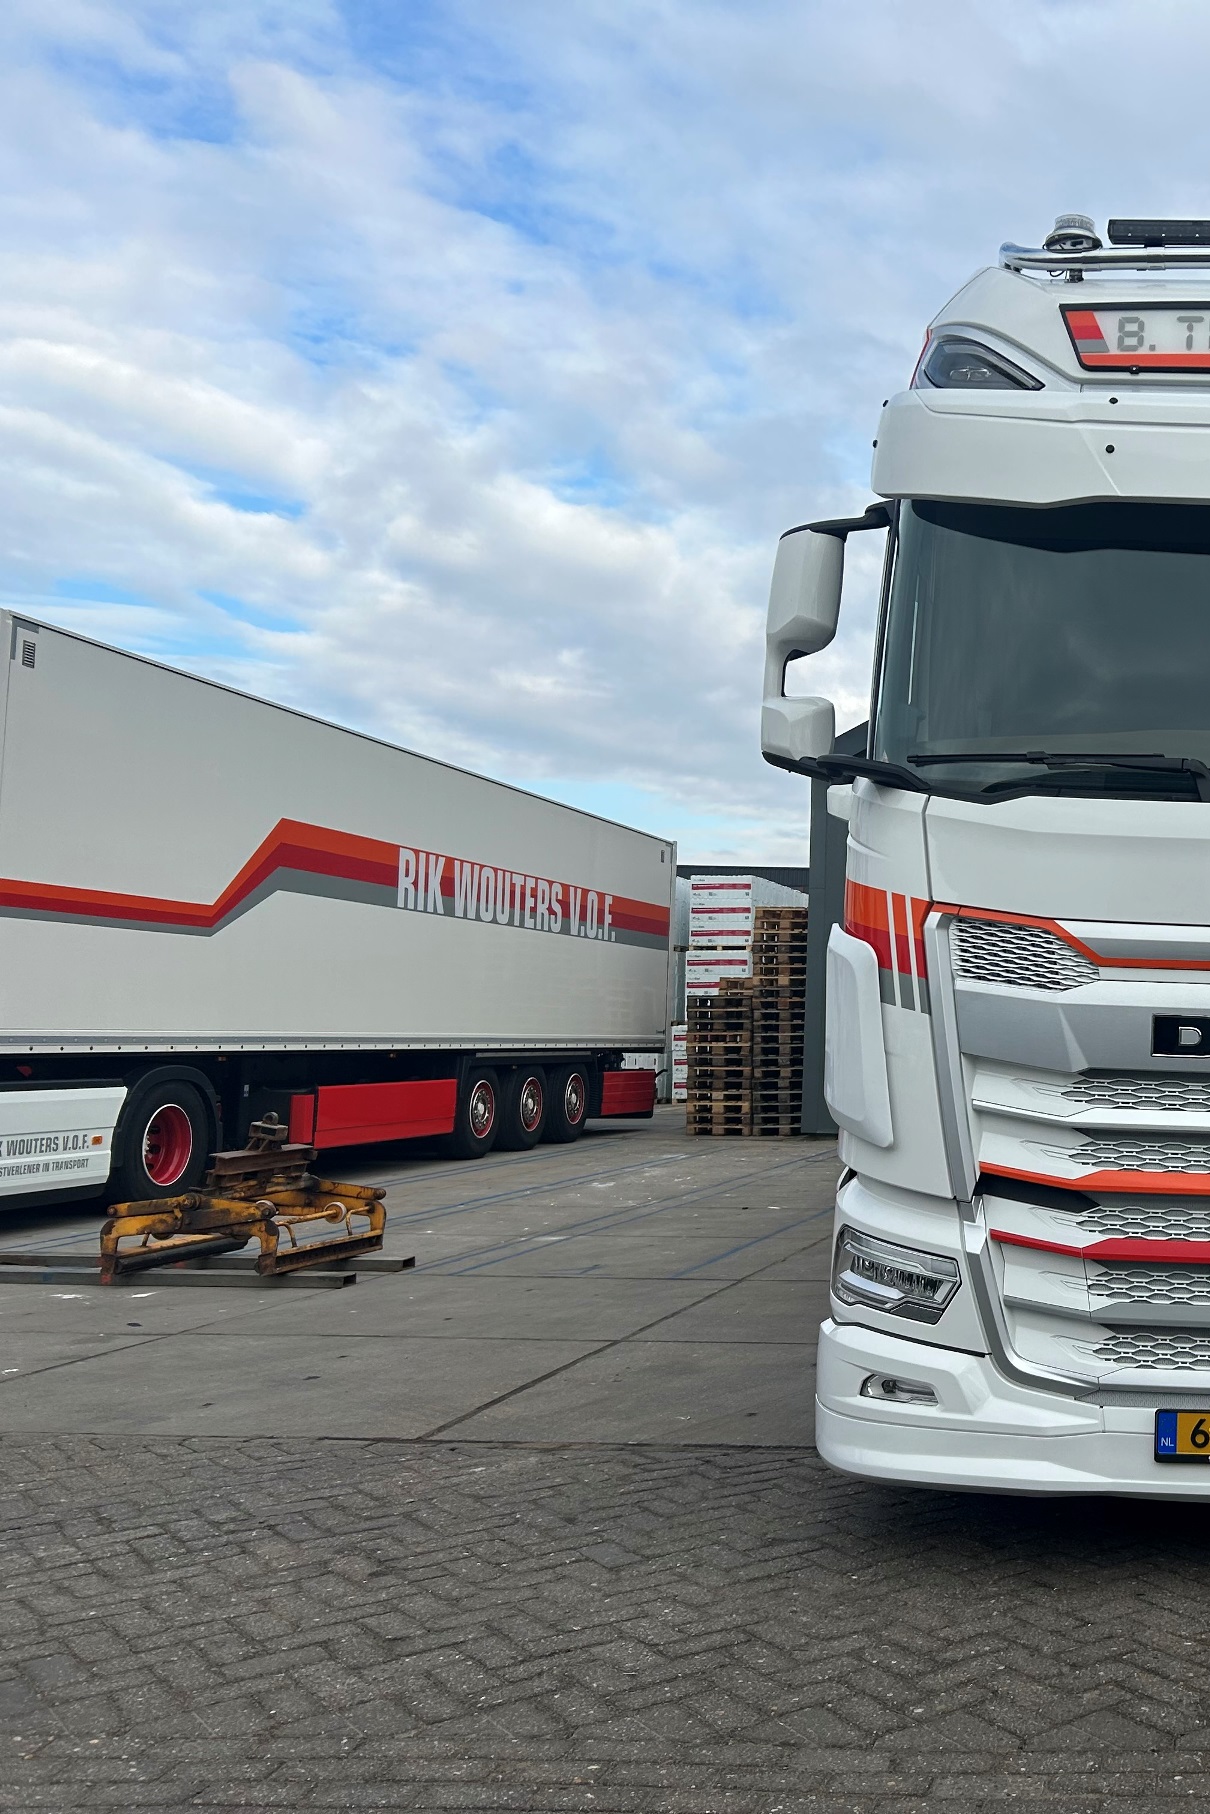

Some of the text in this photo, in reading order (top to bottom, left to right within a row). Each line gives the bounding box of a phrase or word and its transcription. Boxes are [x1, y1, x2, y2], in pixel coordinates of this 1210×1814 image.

[1117, 316, 1156, 351] B.
[397, 847, 616, 942] RIK WOUTERS V.O.F.
[6, 1136, 59, 1156] WOUTERS
[62, 1134, 89, 1151] V.O.F.
[42, 1162, 50, 1172] IN
[52, 1158, 89, 1171] TRANSPORT
[1160, 1437, 1174, 1447] NL
